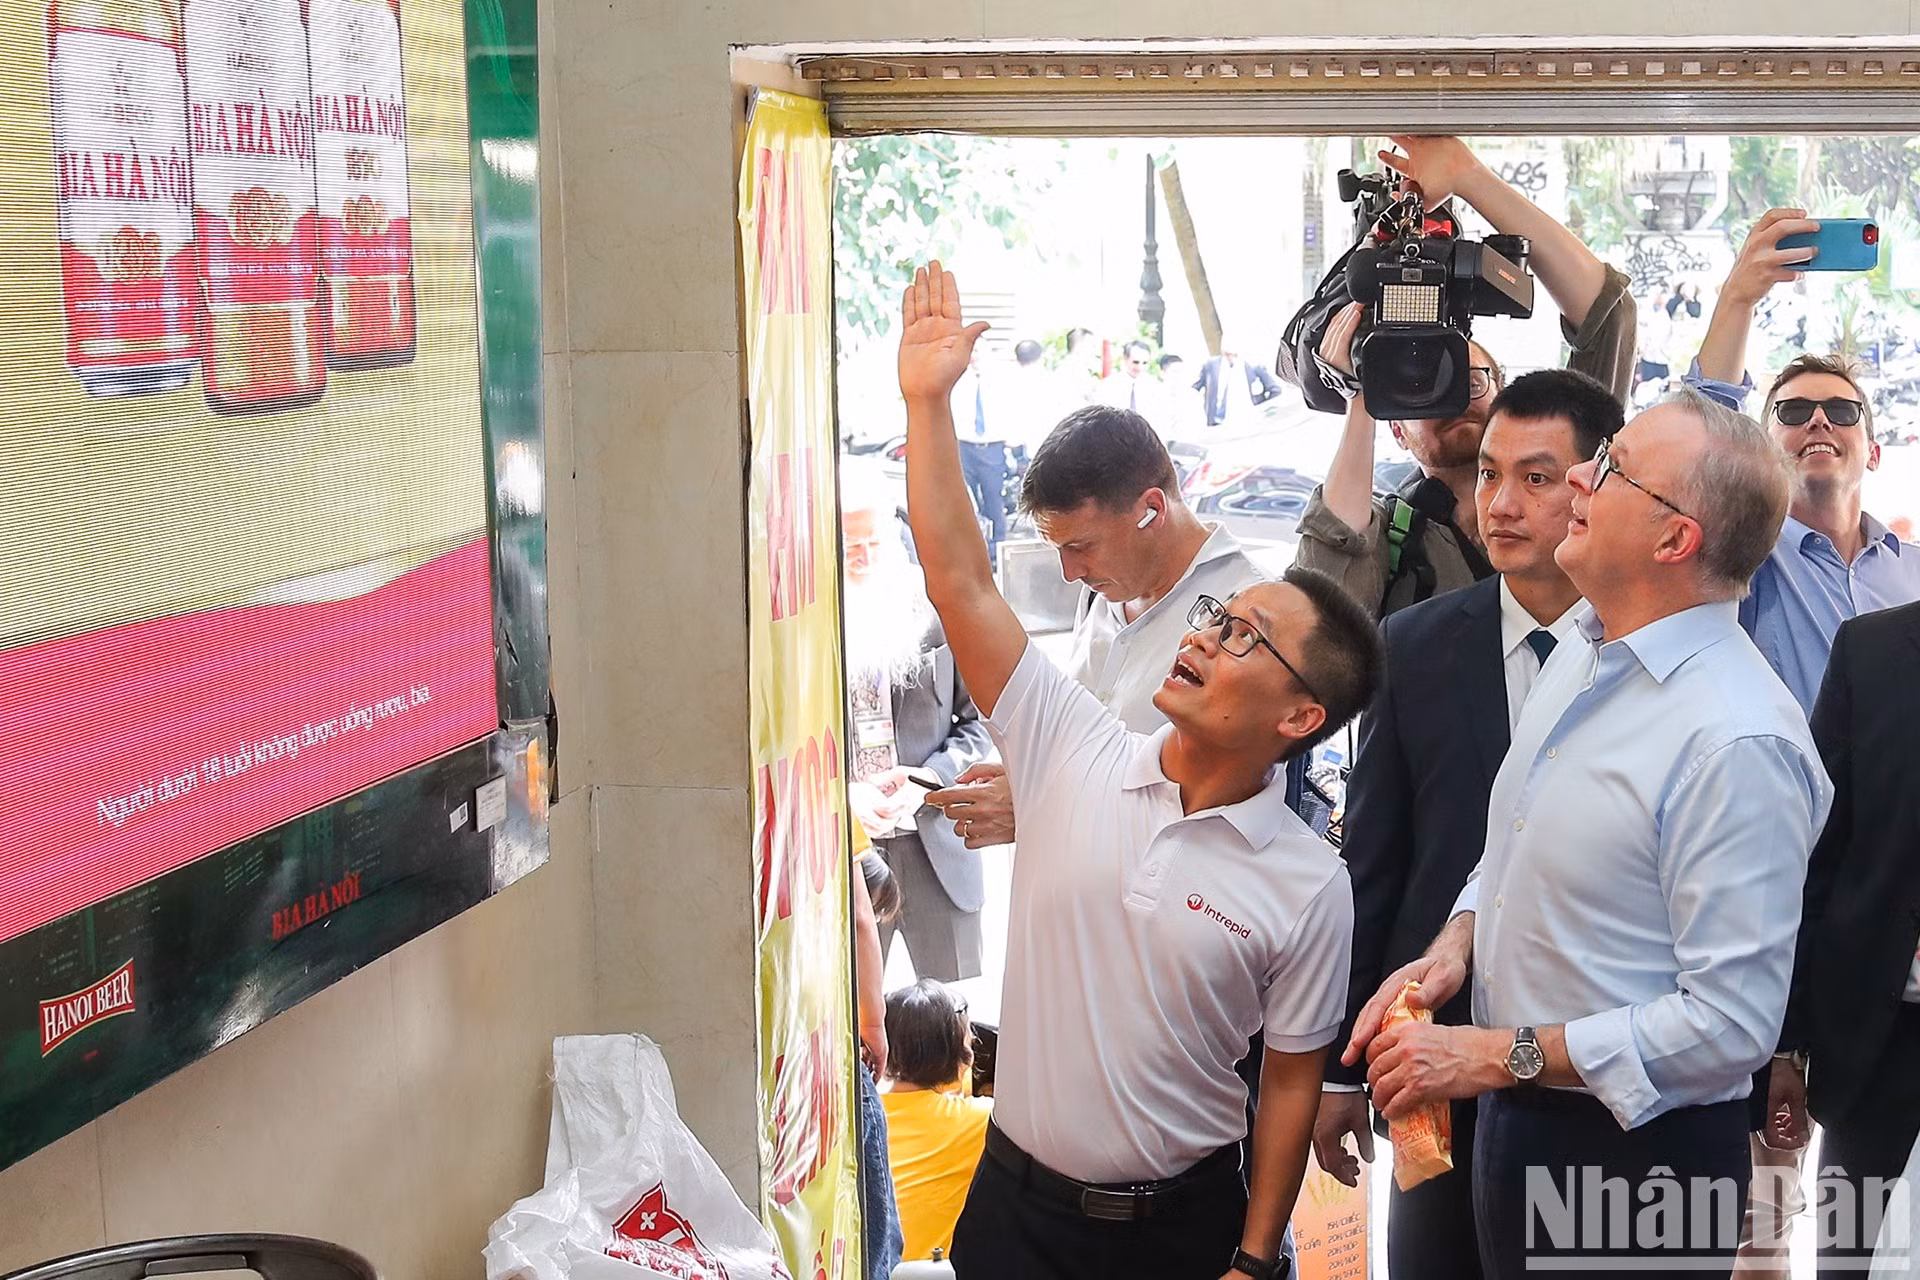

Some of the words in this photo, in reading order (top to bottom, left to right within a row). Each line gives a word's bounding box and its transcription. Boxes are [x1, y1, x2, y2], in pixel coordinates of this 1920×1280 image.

[193, 102, 232, 154] BIA
[234, 88, 275, 155] HÀ
[316, 95, 343, 132] BIA
[345, 84, 374, 134] HÀ
[58, 150, 99, 198] BIA
[102, 136, 149, 199] HÀ
[97, 779, 154, 828] Người
[157, 764, 198, 802] dưới
[201, 755, 222, 784] 18
[223, 741, 252, 776] tuổi
[254, 734, 298, 765] không
[301, 719, 339, 746] được
[340, 702, 373, 733] uống
[272, 902, 303, 941] BIA
[304, 881, 331, 924] HÀ
[1203, 904, 1252, 939] Intrepid
[43, 992, 94, 1046] HANOI
[95, 969, 133, 1015] BEER
